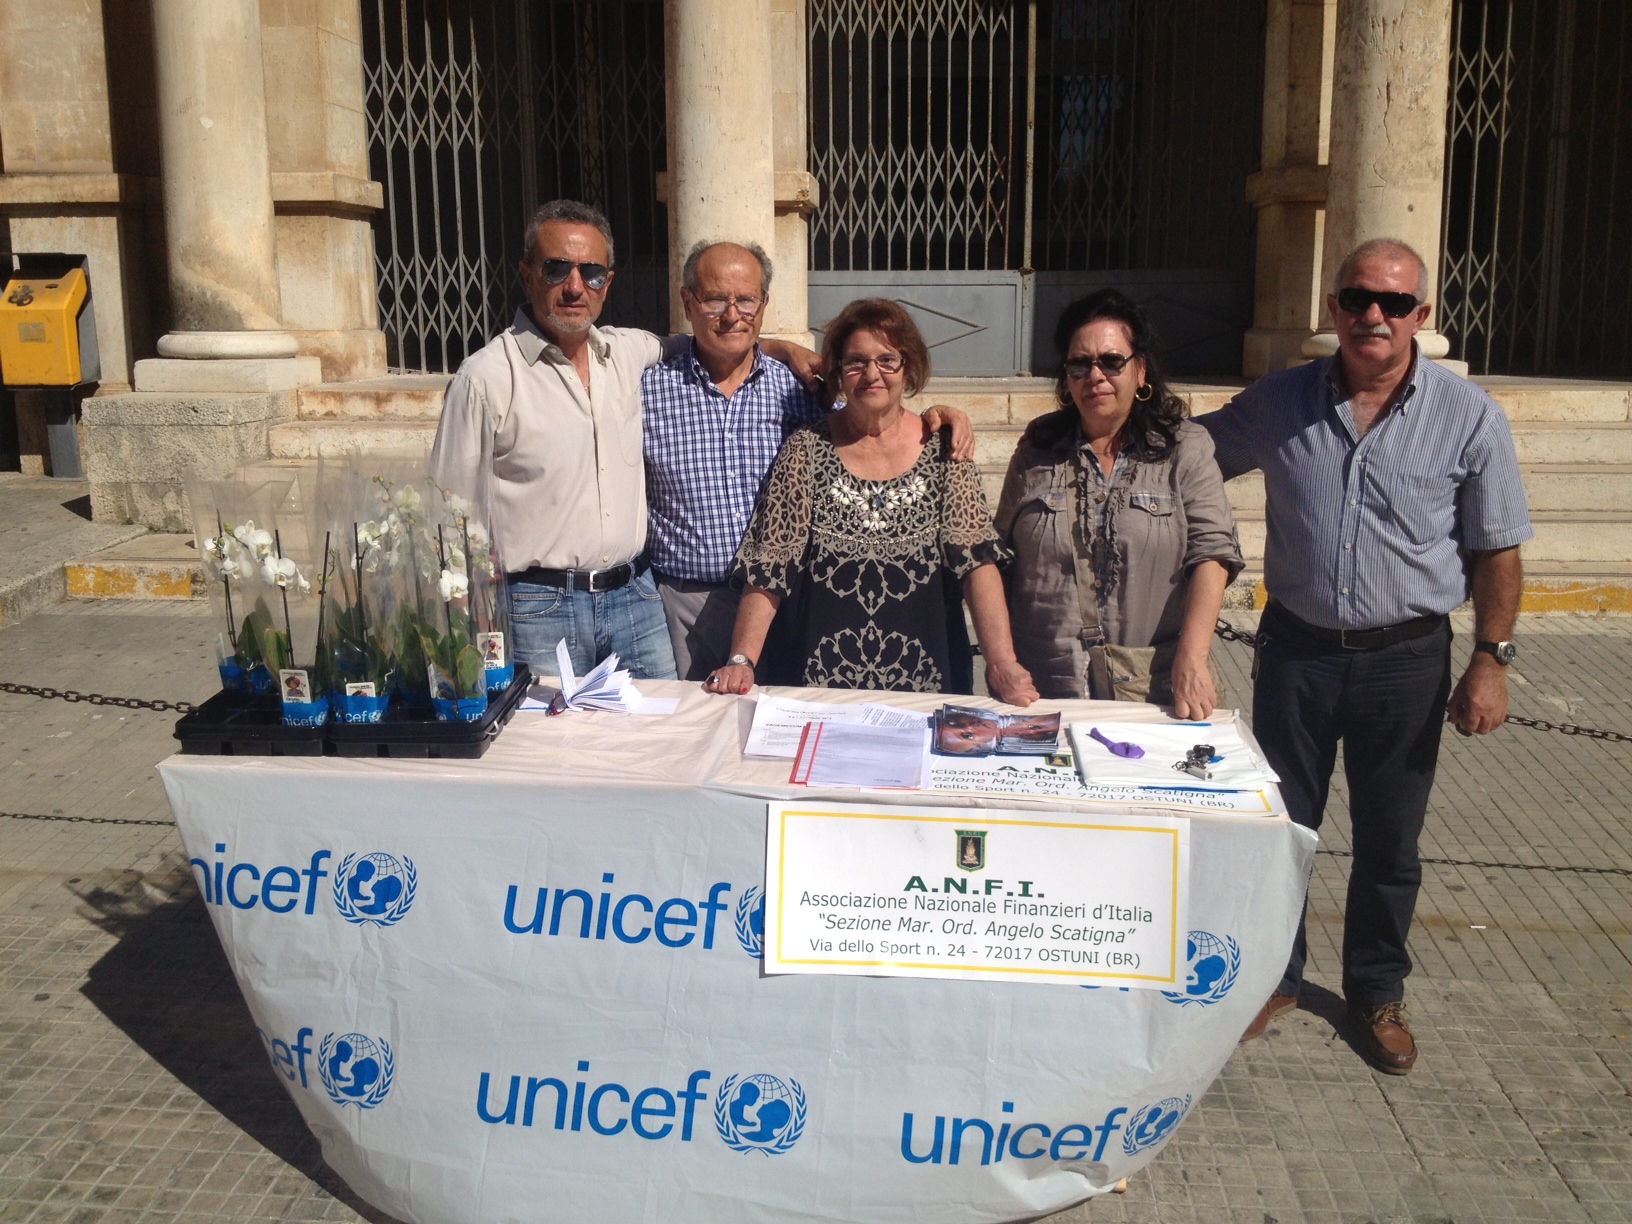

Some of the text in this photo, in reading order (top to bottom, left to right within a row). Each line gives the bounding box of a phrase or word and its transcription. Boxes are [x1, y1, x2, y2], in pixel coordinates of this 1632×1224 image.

[975, 785, 1016, 793] Sport
[1080, 792, 1126, 800] 72017
[1133, 795, 1193, 804] OSTUNI
[1200, 800, 1235, 809] (BR)
[992, 778, 1027, 786] Mar.
[1035, 781, 1070, 789] Ord.
[904, 876, 1045, 898] A.N.F.I.
[503, 873, 731, 950] unicef
[800, 891, 1153, 922] Associazione Nazionale Finanzieri d’Italia
[898, 917, 933, 933] Mar.
[942, 919, 978, 936] Ord.
[985, 921, 1044, 941] Angelo
[810, 939, 832, 952] Via
[839, 939, 874, 953] dello
[880, 941, 921, 956] Sport
[927, 946, 940, 955] n.
[947, 944, 966, 957] 24
[985, 946, 1032, 960] 72017
[1038, 949, 1099, 964] OSTUNI
[1106, 952, 1140, 969] (BR)
[476, 1060, 711, 1141] unicef
[900, 1101, 1128, 1166] unicef
